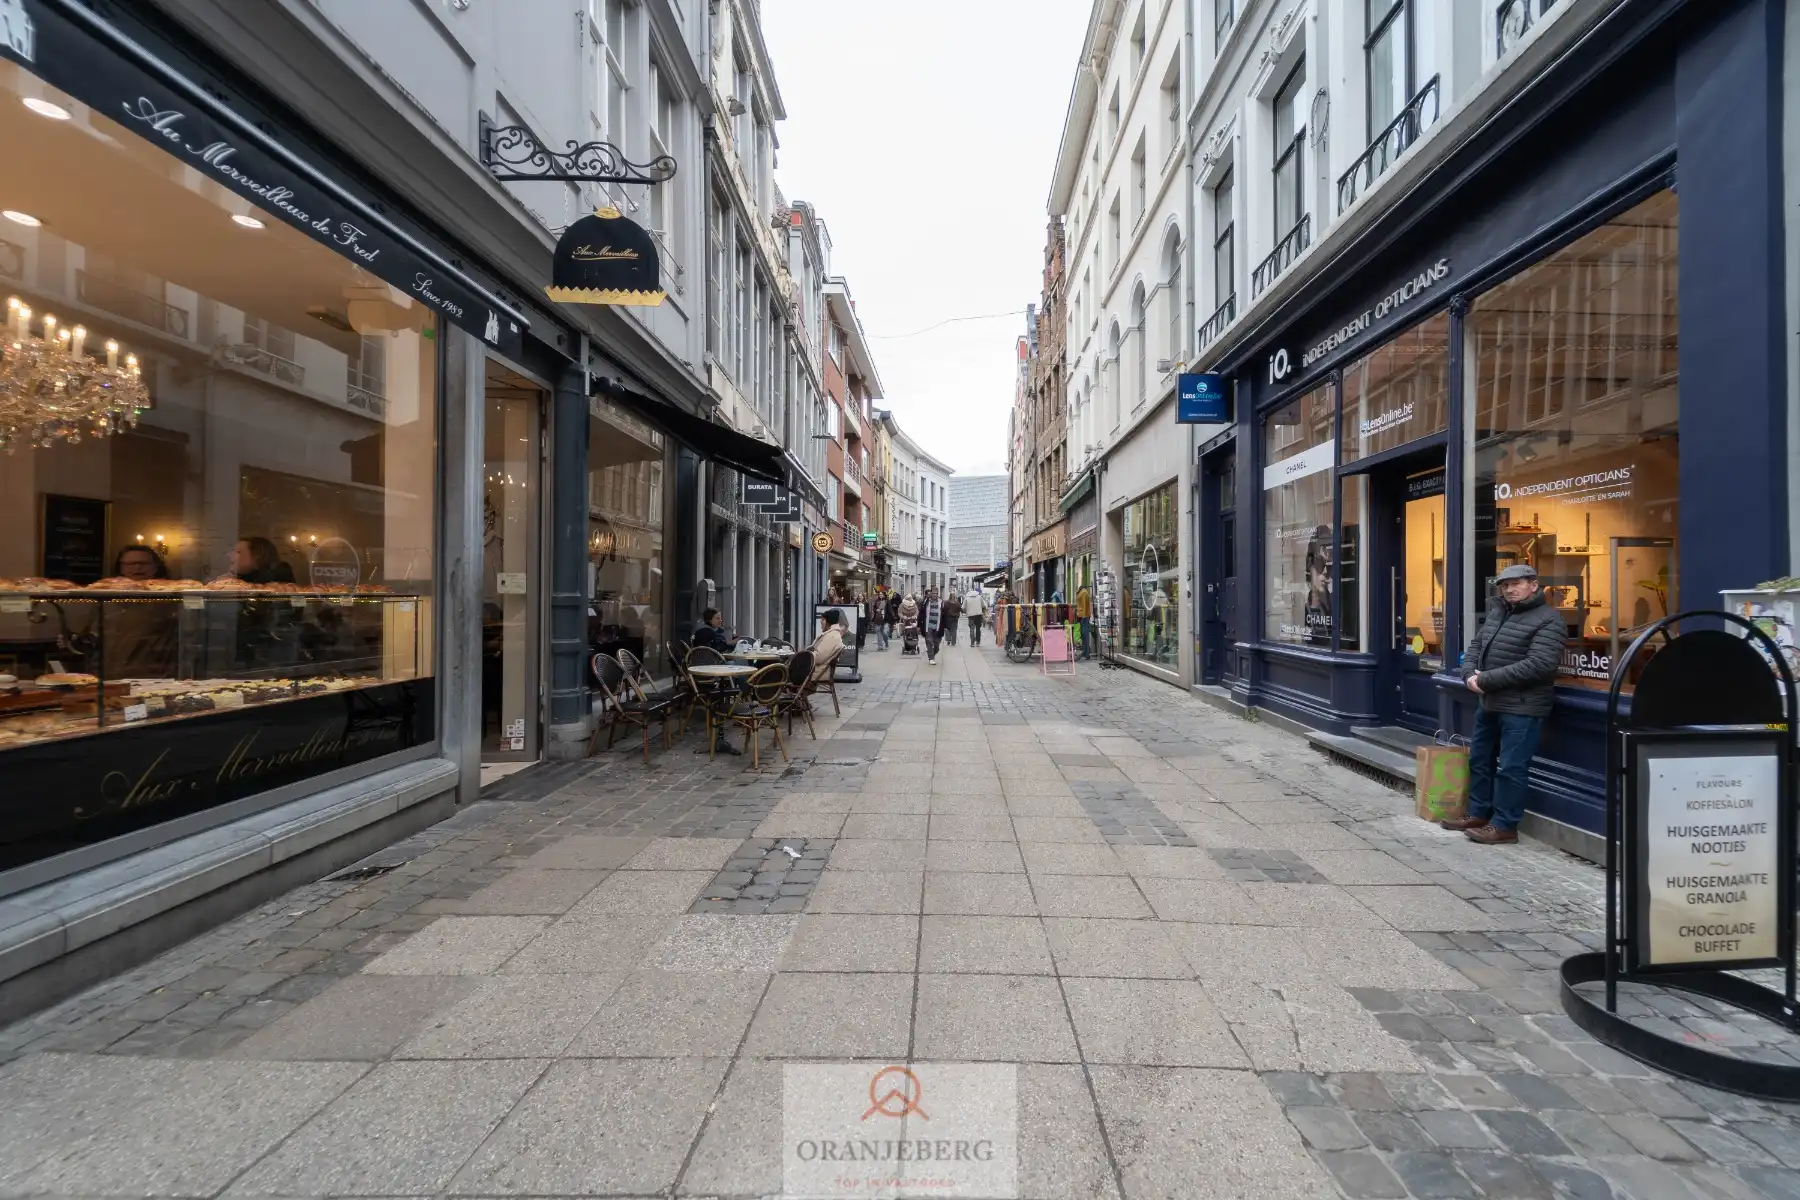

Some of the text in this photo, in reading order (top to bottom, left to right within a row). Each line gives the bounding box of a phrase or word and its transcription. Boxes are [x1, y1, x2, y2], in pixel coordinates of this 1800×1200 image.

[122, 96, 380, 262] Au Merveilleux de Fred
[412, 272, 441, 305] Since
[1375, 258, 1451, 319] OPTICIANS
[1285, 460, 1307, 475] CHANEL
[1574, 467, 1631, 487] OPTICIANS
[1608, 490, 1631, 499] SARAH
[1576, 667, 1610, 679] Centrum
[1696, 780, 1743, 789] FLAVOURS
[1686, 799, 1754, 811] KOFFIESALON
[1667, 822, 1768, 838] HUISGEMAAKTE
[1691, 841, 1747, 854] NOOTJES
[1666, 873, 1769, 889] HUISGEMAAKTE
[1687, 890, 1748, 905] GRANOLA
[1679, 922, 1757, 938] CHOCOLADE
[1695, 939, 1742, 954] BUFFET
